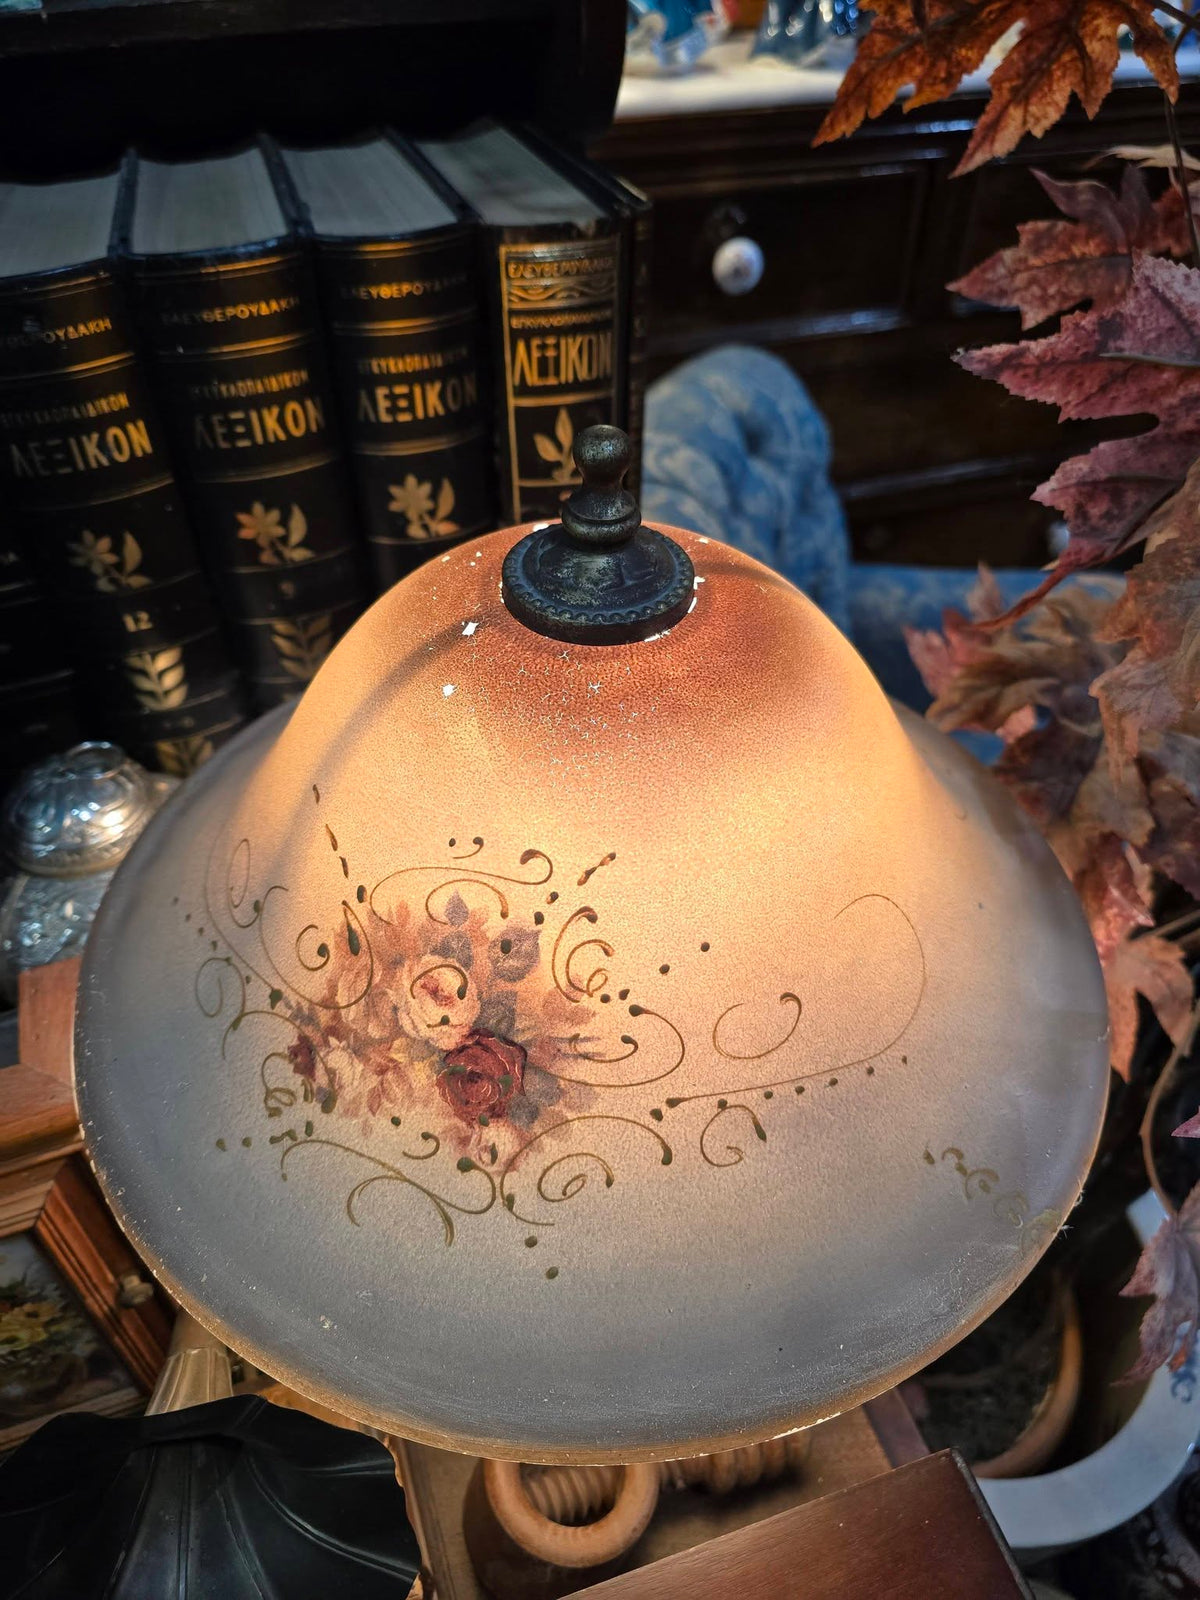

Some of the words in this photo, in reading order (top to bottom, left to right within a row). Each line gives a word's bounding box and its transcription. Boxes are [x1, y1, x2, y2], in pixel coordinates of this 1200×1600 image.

[513, 332, 613, 388] ΛΕΞΙΚΟΝ
[193, 396, 326, 450] ΛΕΞΙΚΟΝ
[357, 371, 477, 424] ΛΕΞΙΚΟΝ
[10, 418, 153, 479] ΛΕΞΙΚΟΝ
